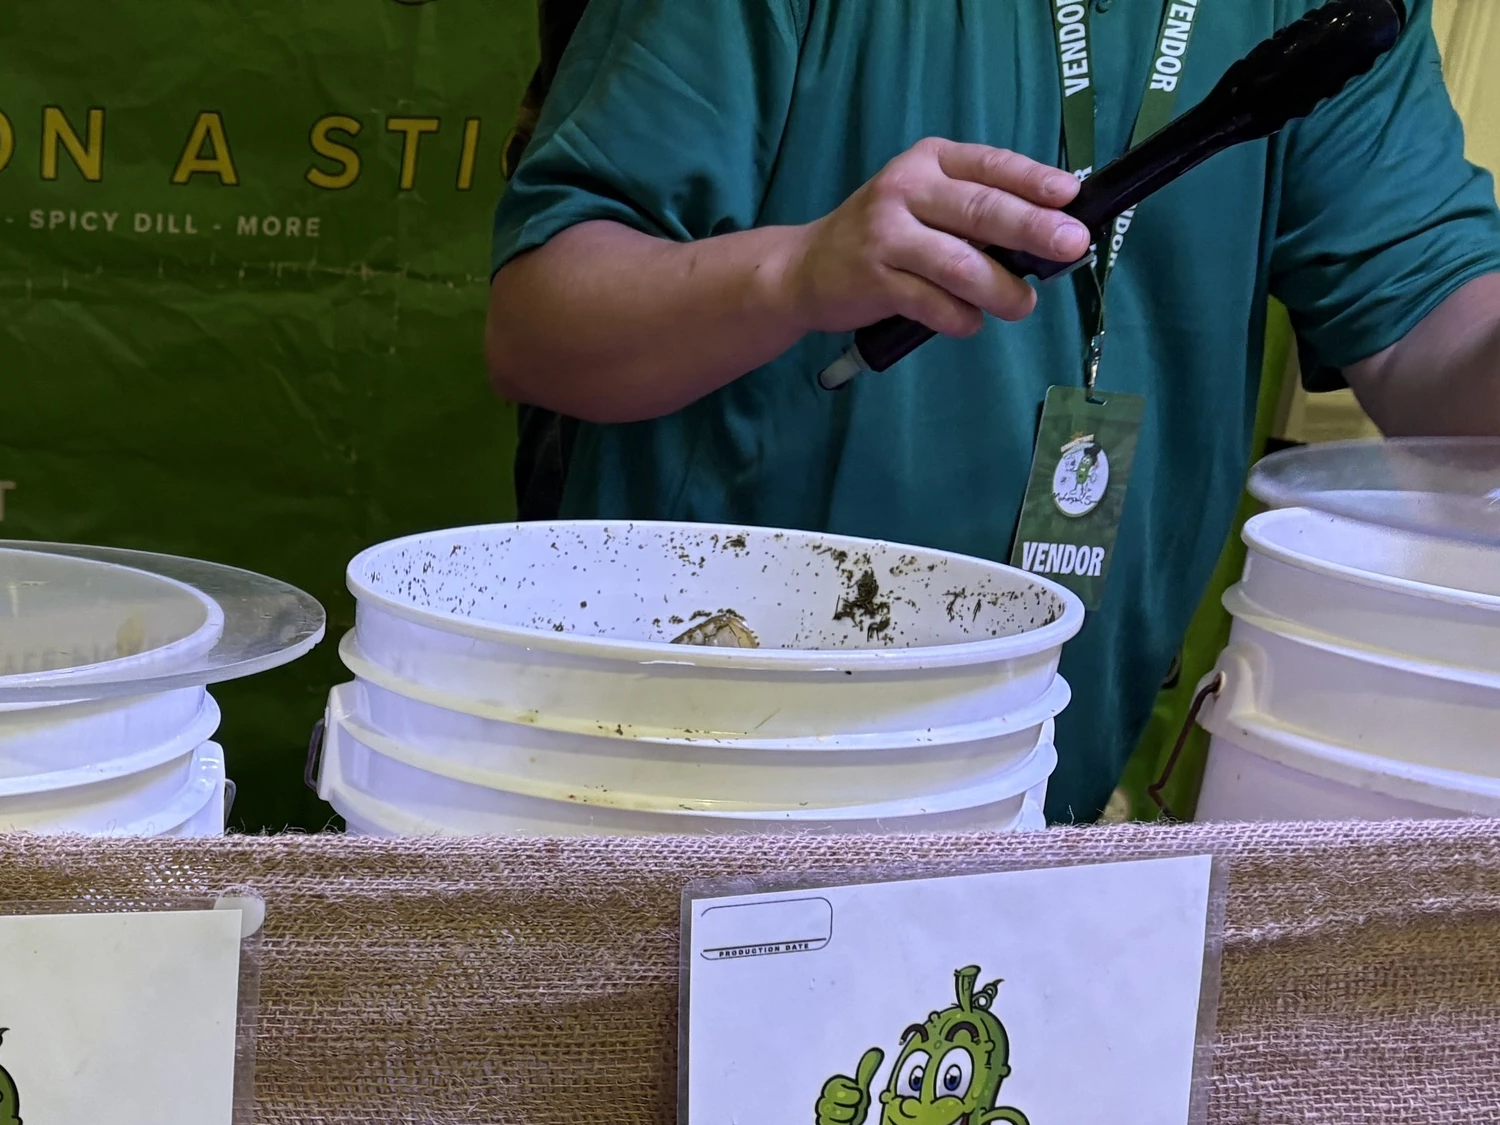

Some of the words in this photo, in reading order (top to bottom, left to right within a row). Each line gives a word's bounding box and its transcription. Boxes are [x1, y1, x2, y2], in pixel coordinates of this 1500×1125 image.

[1056, 0, 1089, 97] VENDO
[170, 110, 239, 186] A
[305, 113, 515, 191] STI
[29, 209, 119, 233] SPICY
[134, 212, 198, 235] DILL
[236, 215, 321, 238] MORE
[1022, 541, 1105, 577] VENDOR
[719, 944, 781, 957] PRODUCTION
[785, 942, 810, 951] DATE
